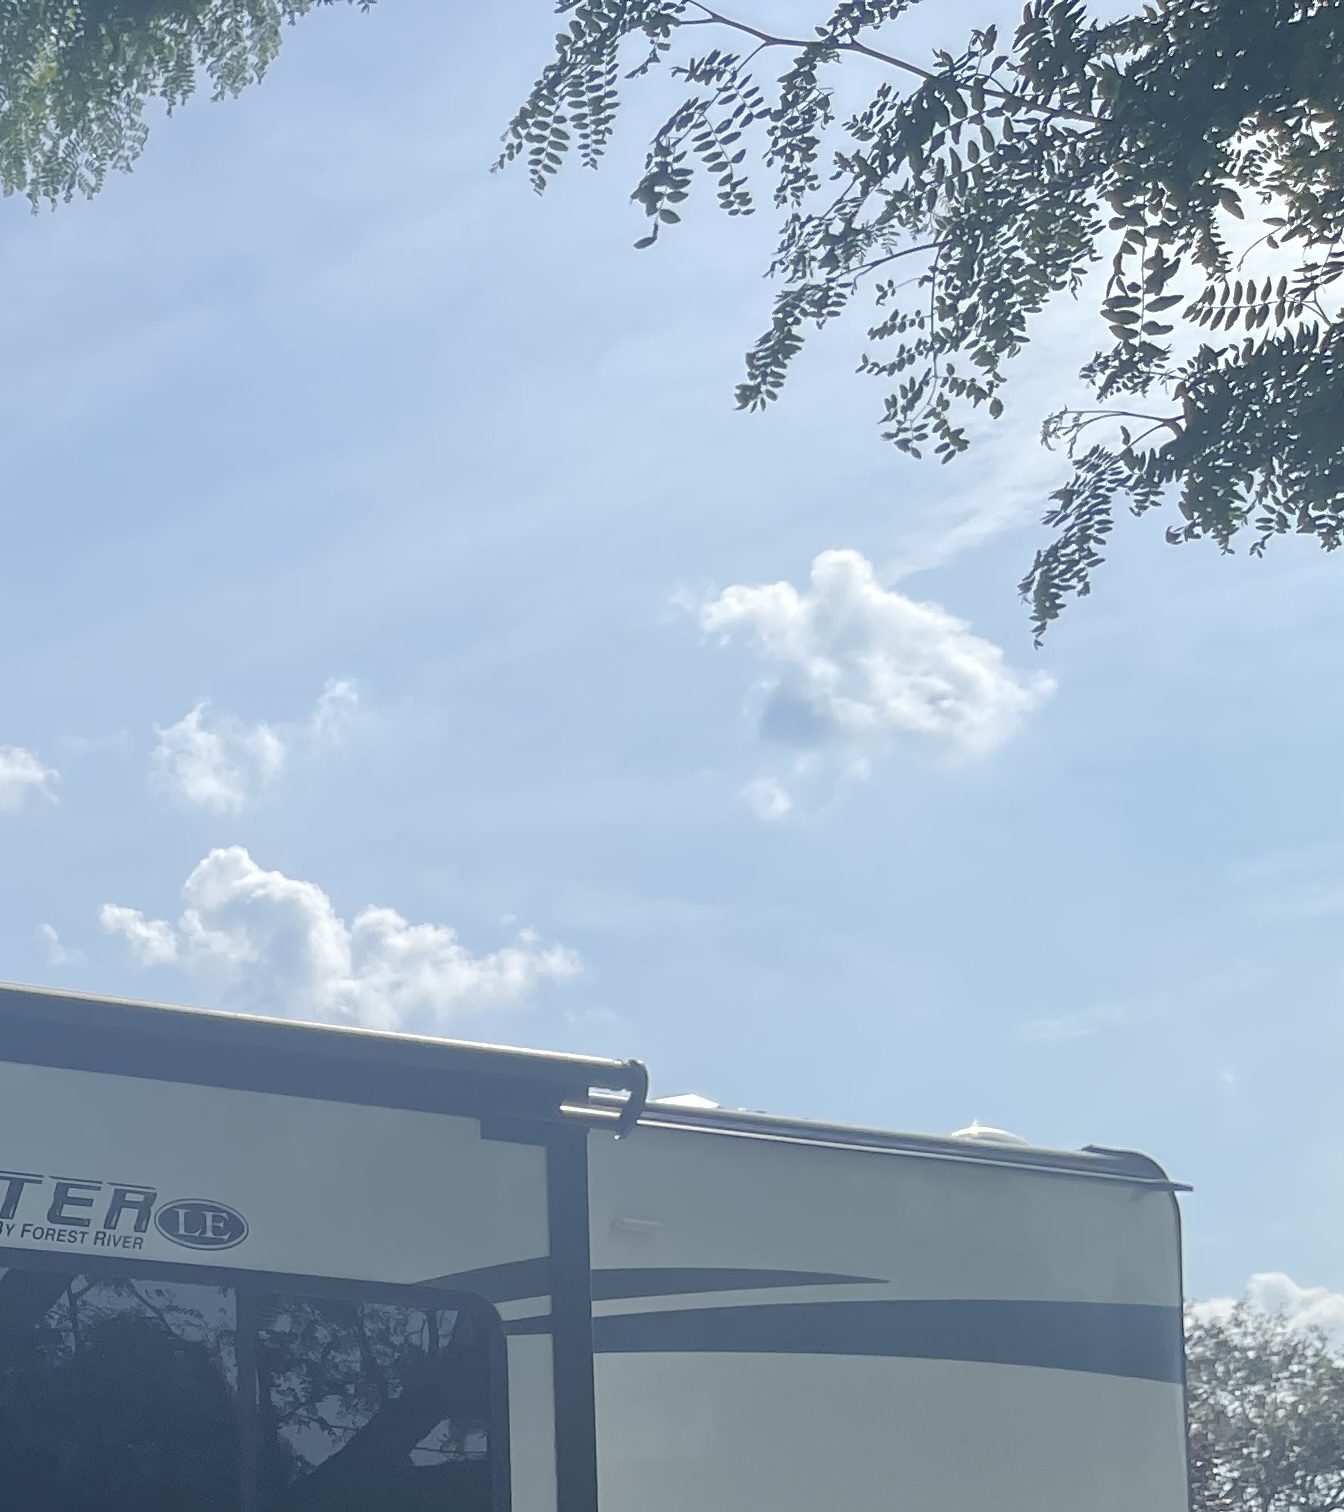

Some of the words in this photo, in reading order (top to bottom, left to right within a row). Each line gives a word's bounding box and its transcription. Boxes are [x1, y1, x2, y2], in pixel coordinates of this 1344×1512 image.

[20, 1223, 89, 1245] FOREST
[93, 1230, 145, 1251] RIVER
[173, 1207, 233, 1241] LE
